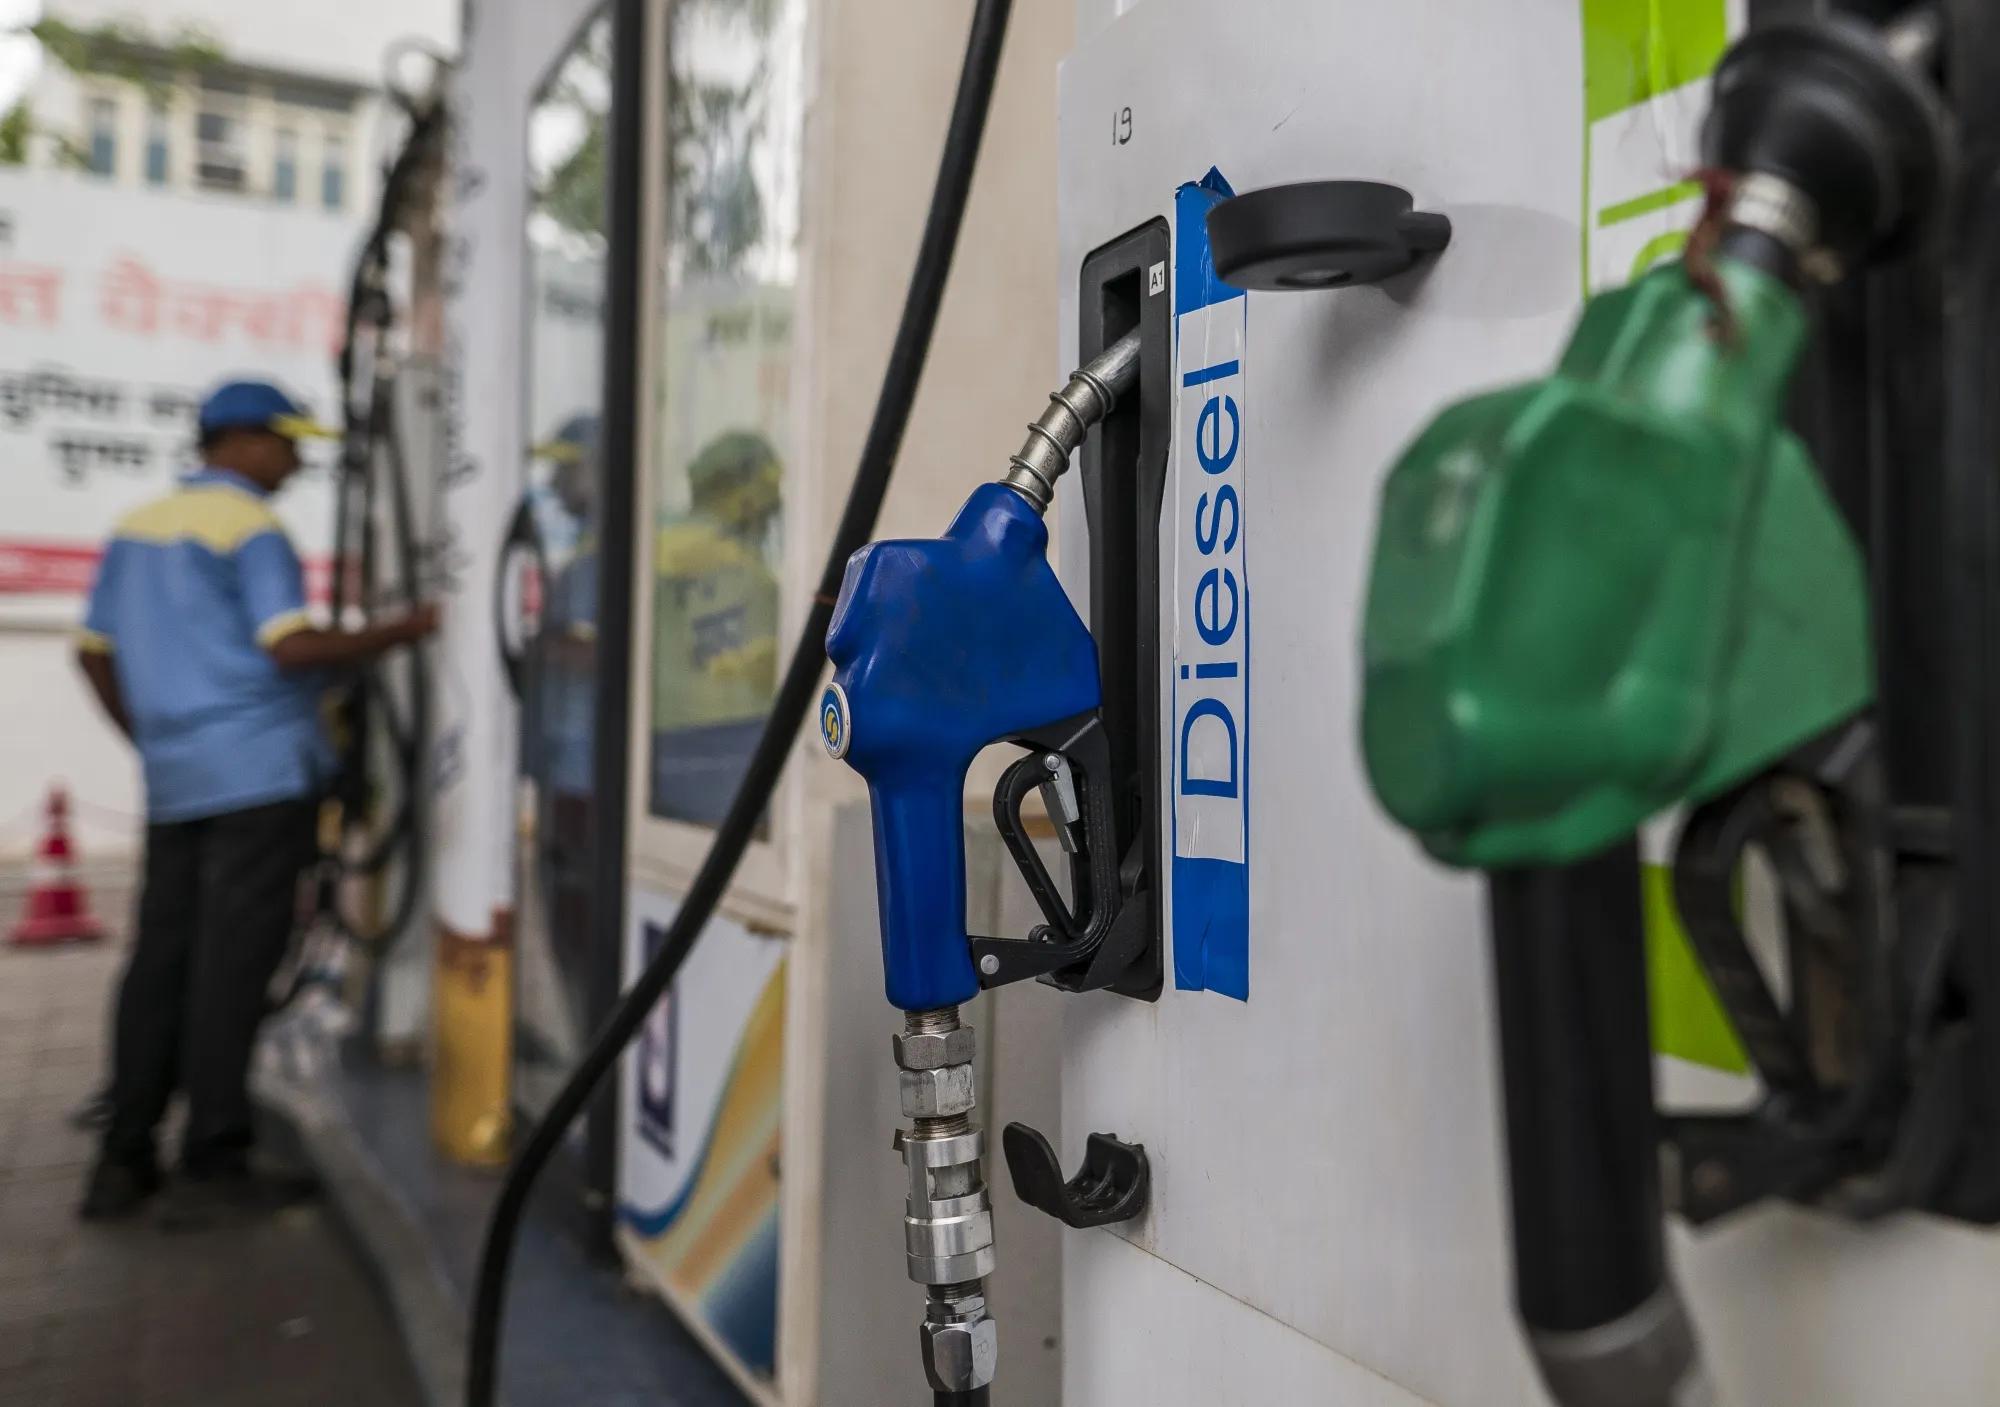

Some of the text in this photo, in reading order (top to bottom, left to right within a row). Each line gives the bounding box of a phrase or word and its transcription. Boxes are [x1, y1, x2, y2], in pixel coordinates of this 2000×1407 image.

[1112, 106, 1133, 146] 19
[1151, 269, 1164, 290] A1
[1180, 359, 1240, 799] Diesel
